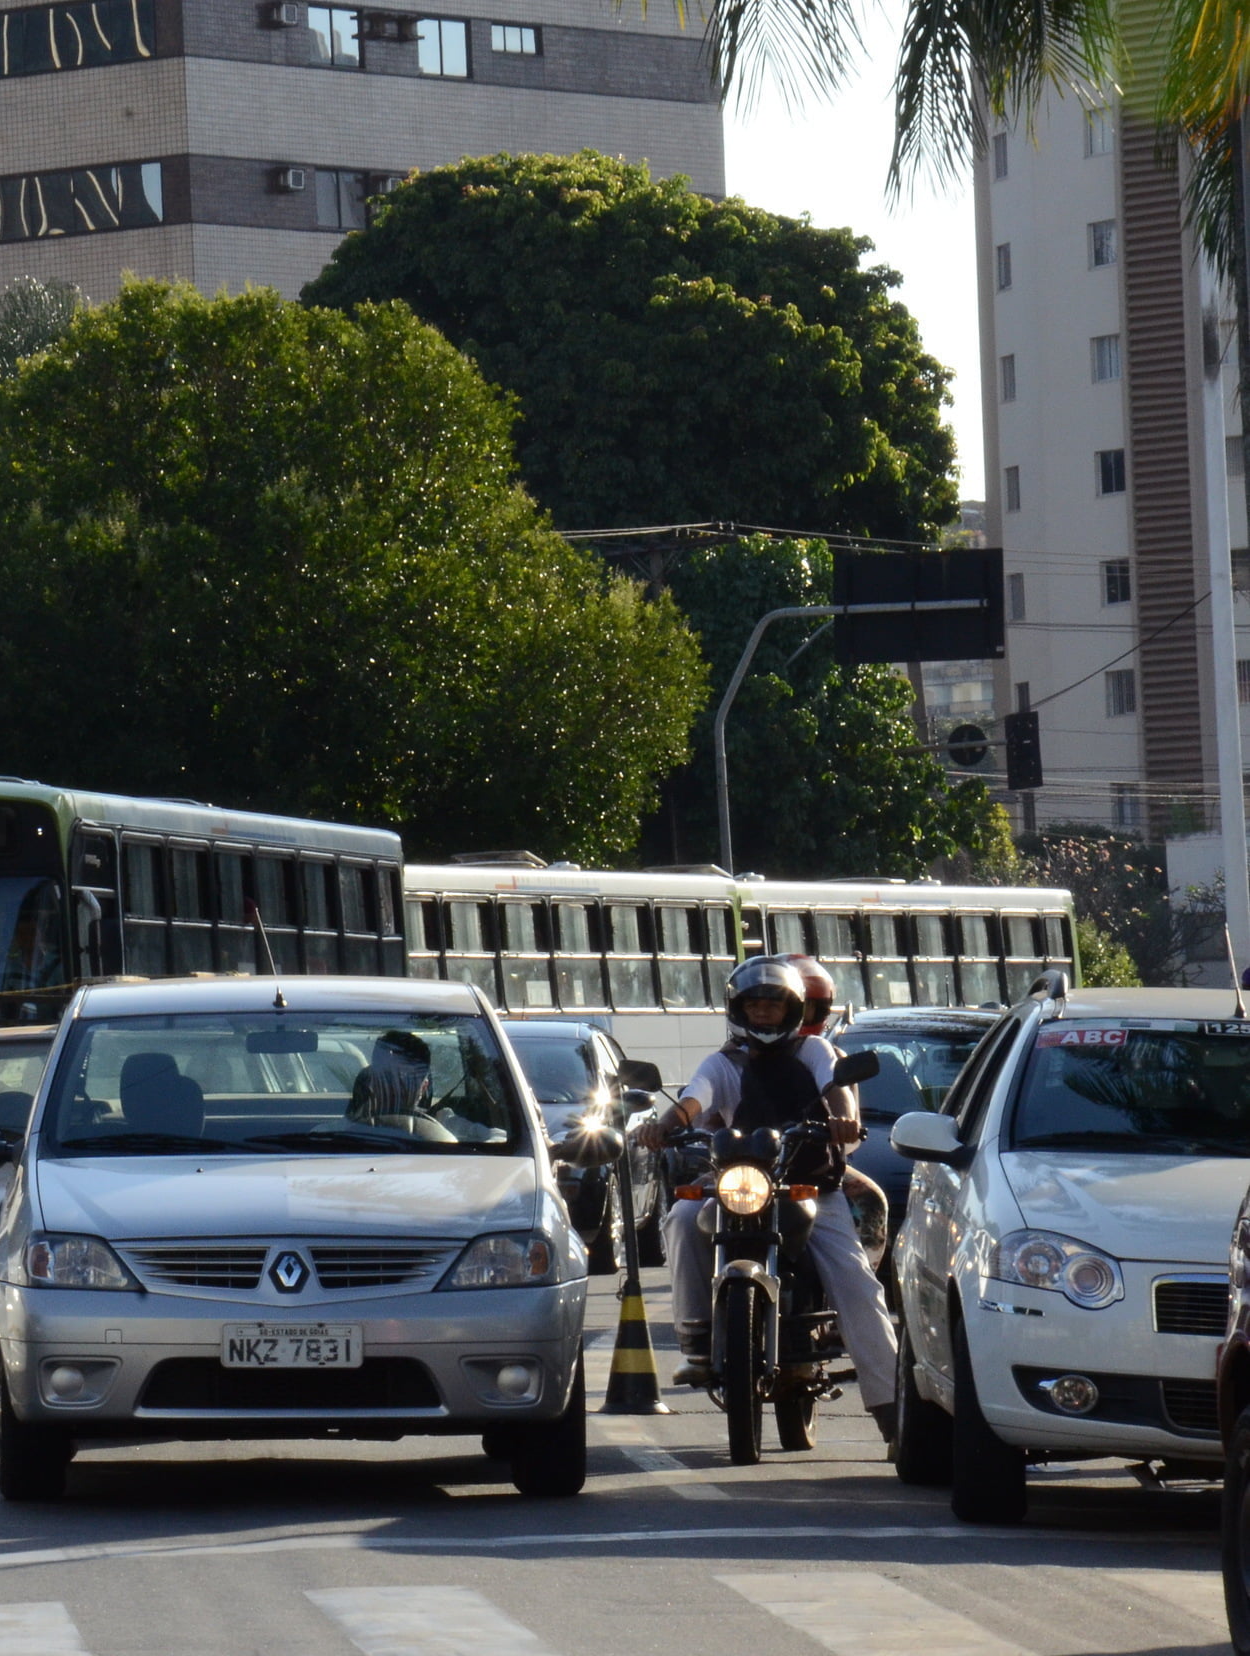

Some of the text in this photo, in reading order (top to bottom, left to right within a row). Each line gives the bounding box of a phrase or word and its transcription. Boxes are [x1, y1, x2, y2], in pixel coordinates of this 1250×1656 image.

[1060, 1030, 1124, 1045] ABC
[229, 1338, 351, 1363] NKZ 7831
